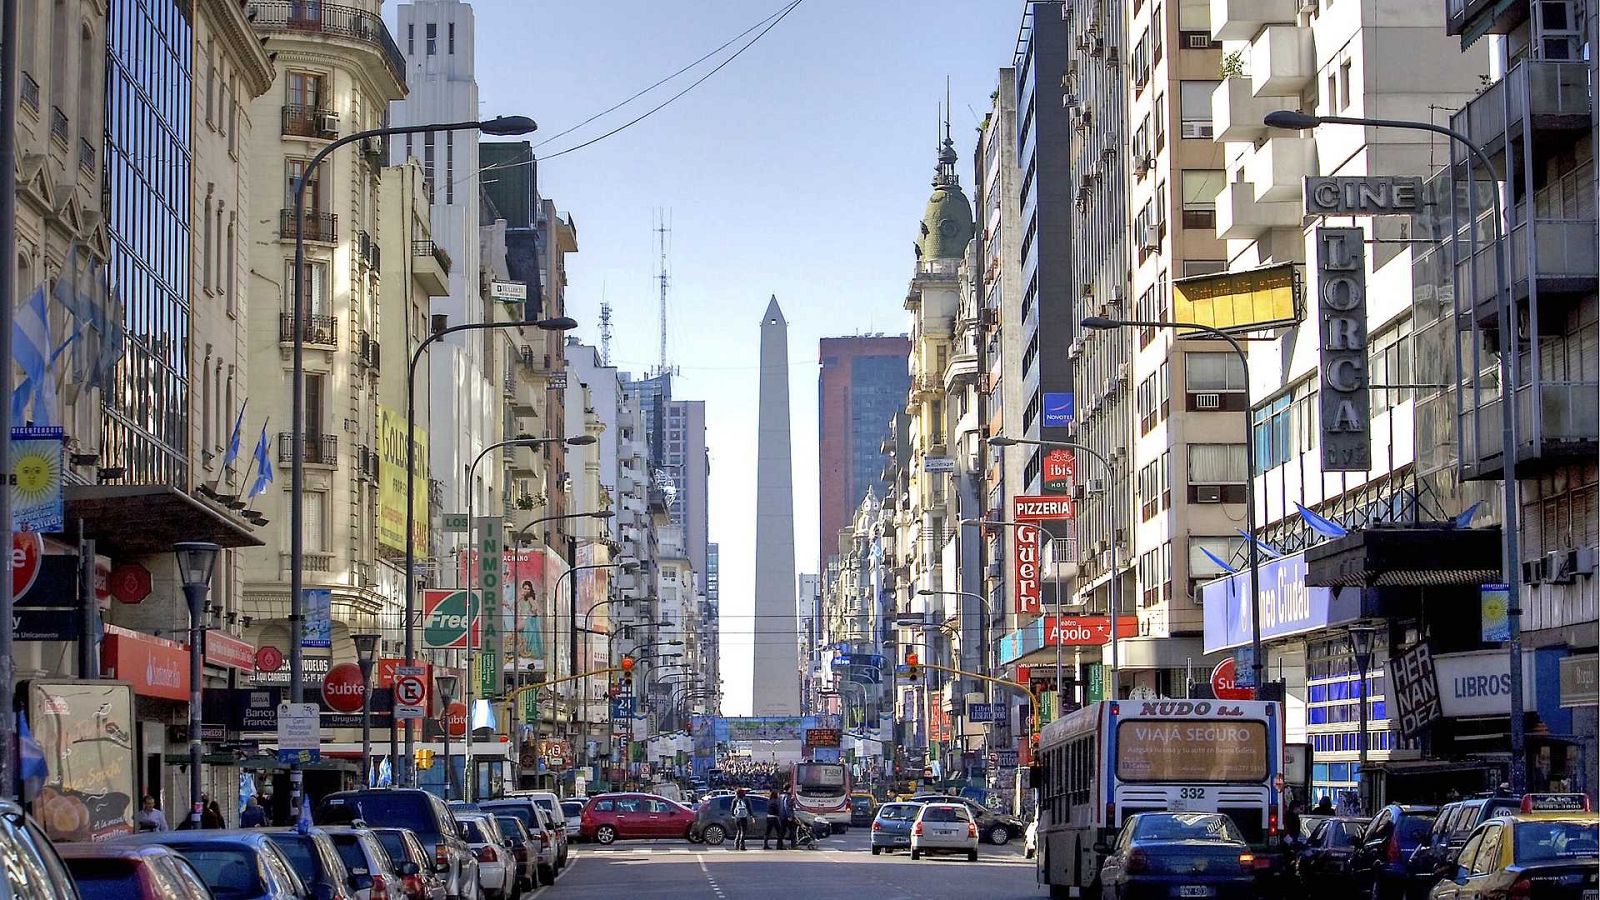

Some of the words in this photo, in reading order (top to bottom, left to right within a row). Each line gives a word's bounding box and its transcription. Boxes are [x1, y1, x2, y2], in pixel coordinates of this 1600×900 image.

[1313, 182, 1416, 208] CINE
[1322, 235, 1364, 432] LORCA
[382, 411, 425, 480] GOLDSEIN
[1050, 464, 1072, 476] ibis
[1017, 502, 1069, 515] PIZZERIA
[446, 518, 468, 527] LOS
[1278, 564, 1310, 623] Ciudad
[428, 611, 468, 628] Free
[1050, 625, 1091, 644] Apolo
[1392, 643, 1431, 690] HER
[327, 682, 365, 695] Subte
[405, 683, 416, 699] E
[1454, 673, 1511, 699] LIBROS
[1399, 674, 1436, 716] NAN
[246, 709, 275, 717] Banco
[1139, 702, 1211, 716] NUDO
[1402, 699, 1440, 734] DEZ
[1186, 728, 1250, 742] SEGURO
[1180, 788, 1205, 799] 332
